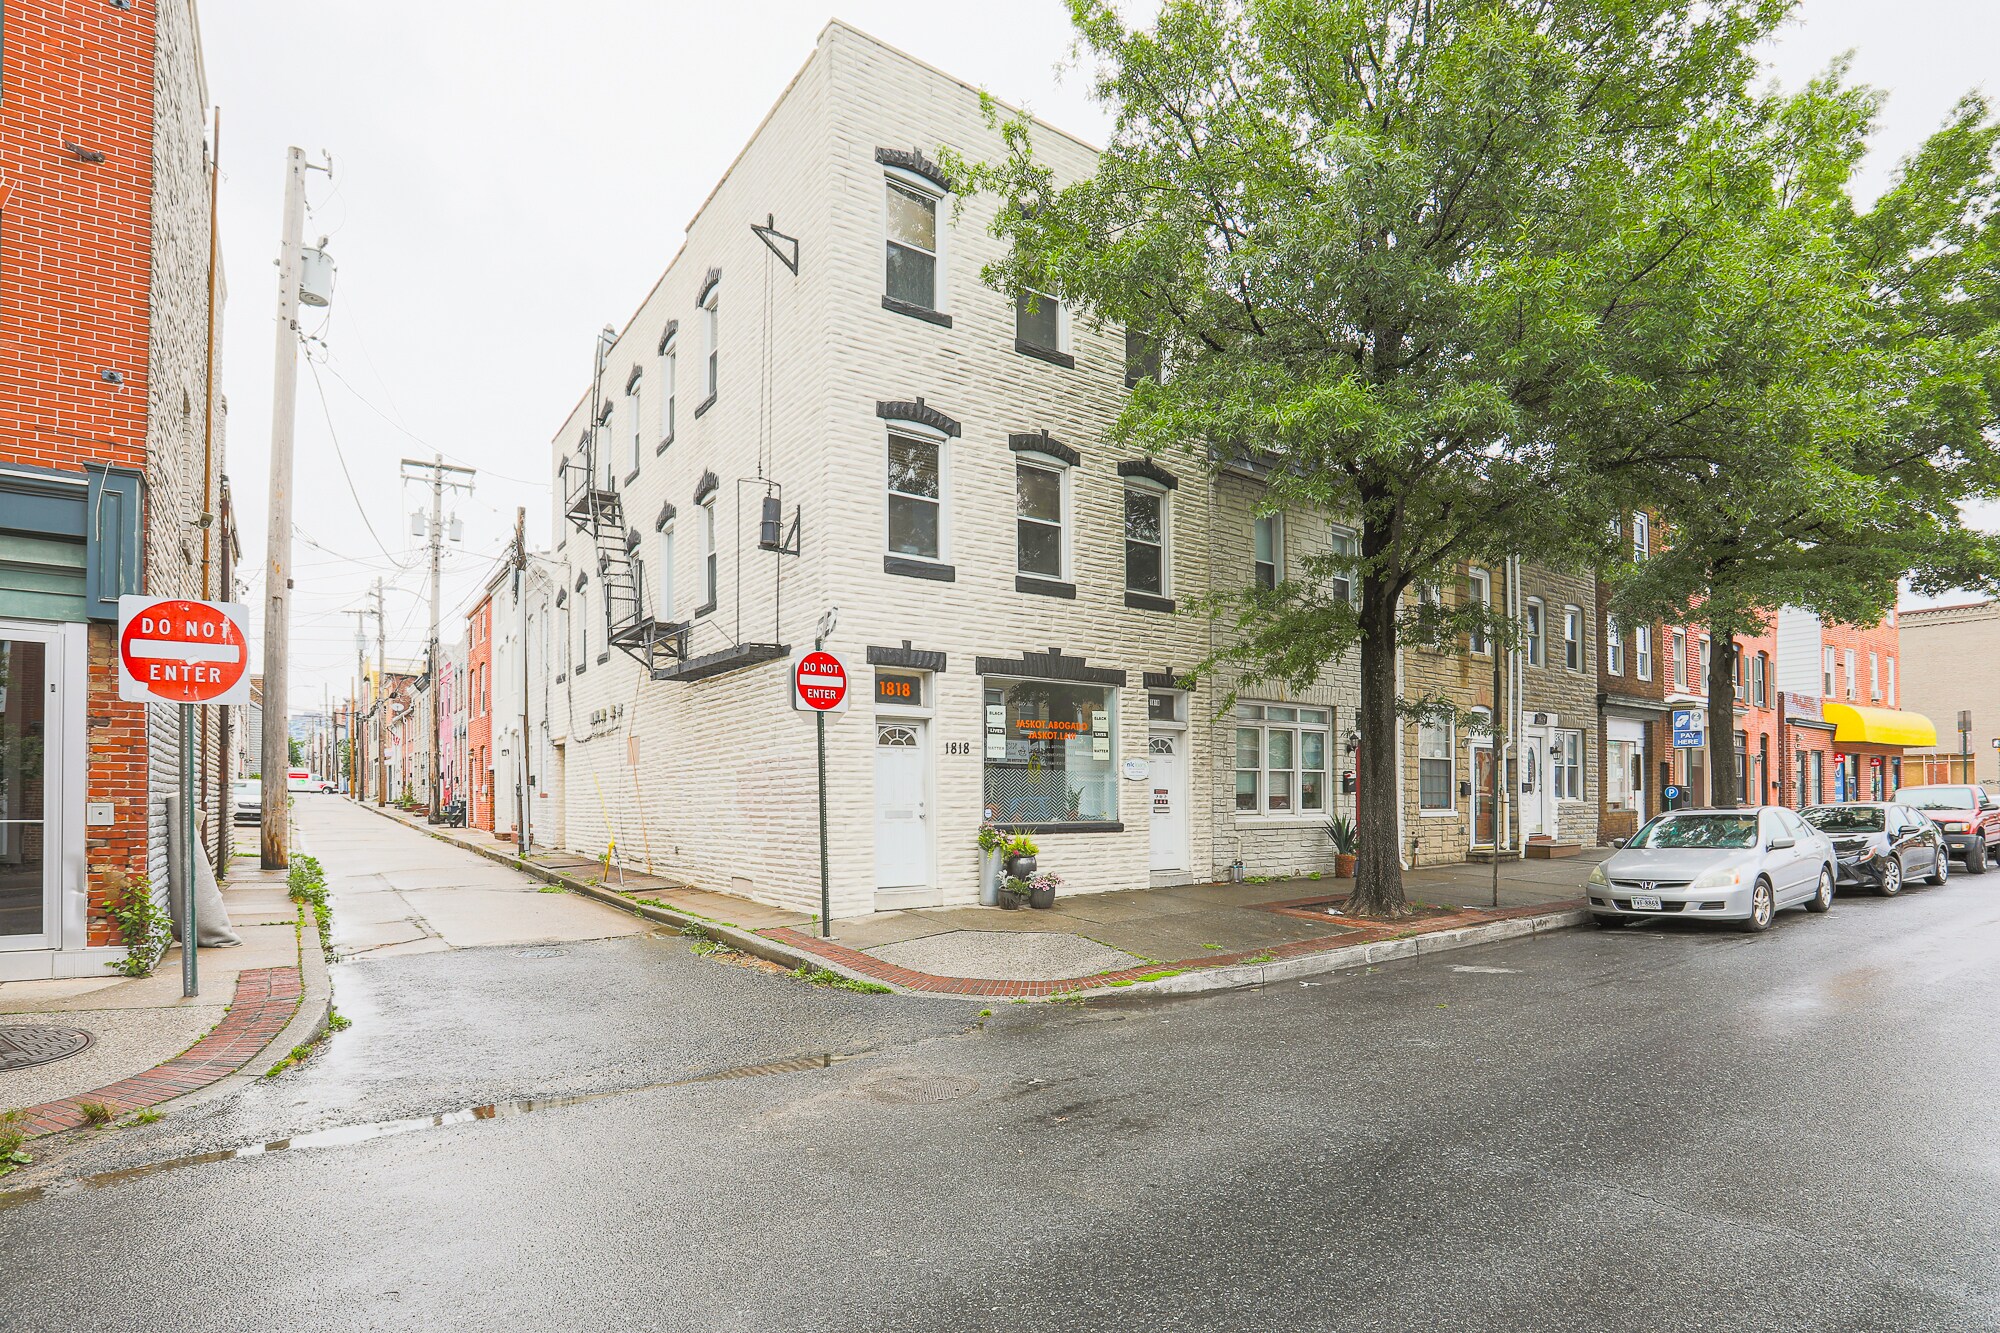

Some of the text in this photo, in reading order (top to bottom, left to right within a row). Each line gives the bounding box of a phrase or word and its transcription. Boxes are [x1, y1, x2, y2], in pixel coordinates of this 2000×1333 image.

[142, 617, 229, 639] DO NOT
[149, 664, 221, 683] ENTER
[803, 662, 838, 674] DO NOT
[807, 688, 836, 699] ENTER
[880, 681, 910, 697] 1818
[1015, 719, 1088, 731] JASKOT.ABOGADO
[1028, 730, 1077, 740] JASKOT.LAW
[945, 741, 970, 754] 1818
[1668, 788, 1676, 797] P
